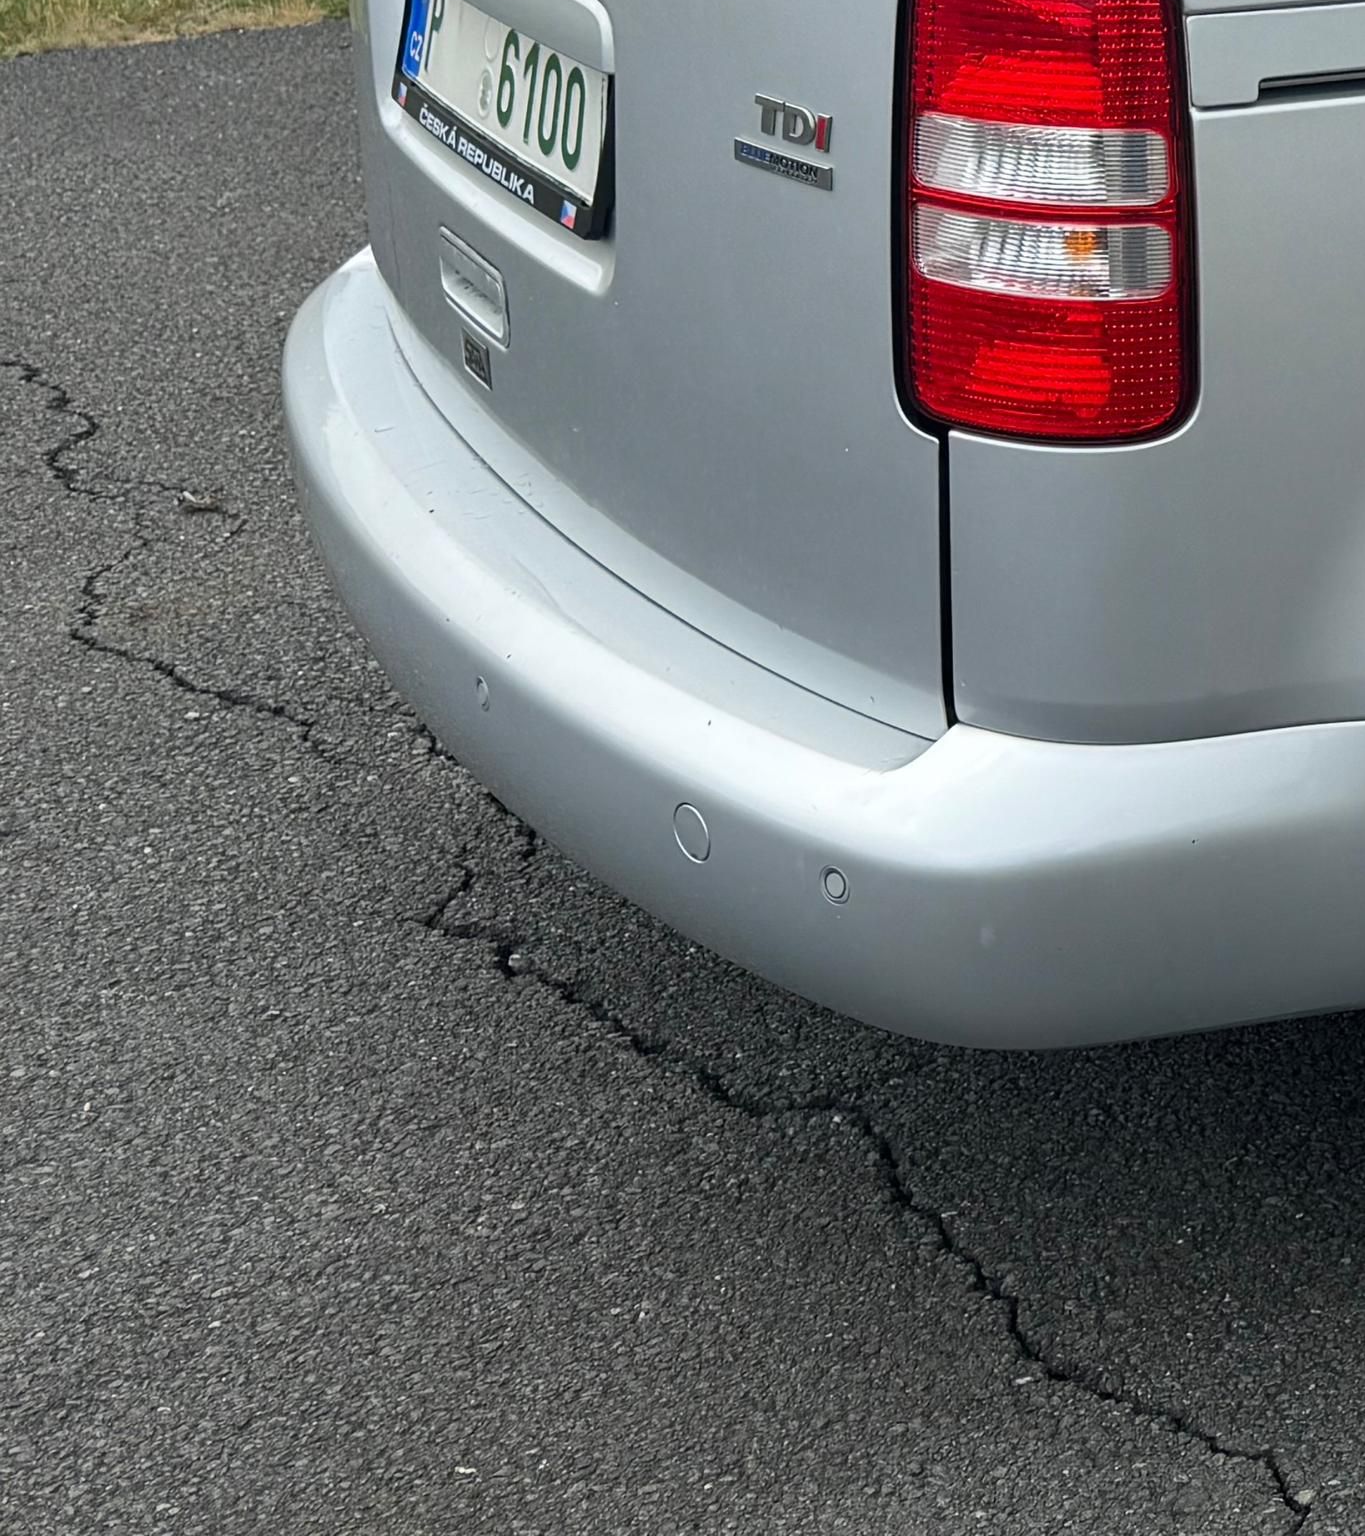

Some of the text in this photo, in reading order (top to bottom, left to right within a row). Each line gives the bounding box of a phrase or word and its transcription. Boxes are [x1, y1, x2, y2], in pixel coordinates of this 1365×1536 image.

[410, 30, 423, 62] CZ
[497, 28, 586, 171] 6100
[755, 92, 832, 154] TDI
[419, 103, 535, 205] ČESKÁ REPUBLIKA
